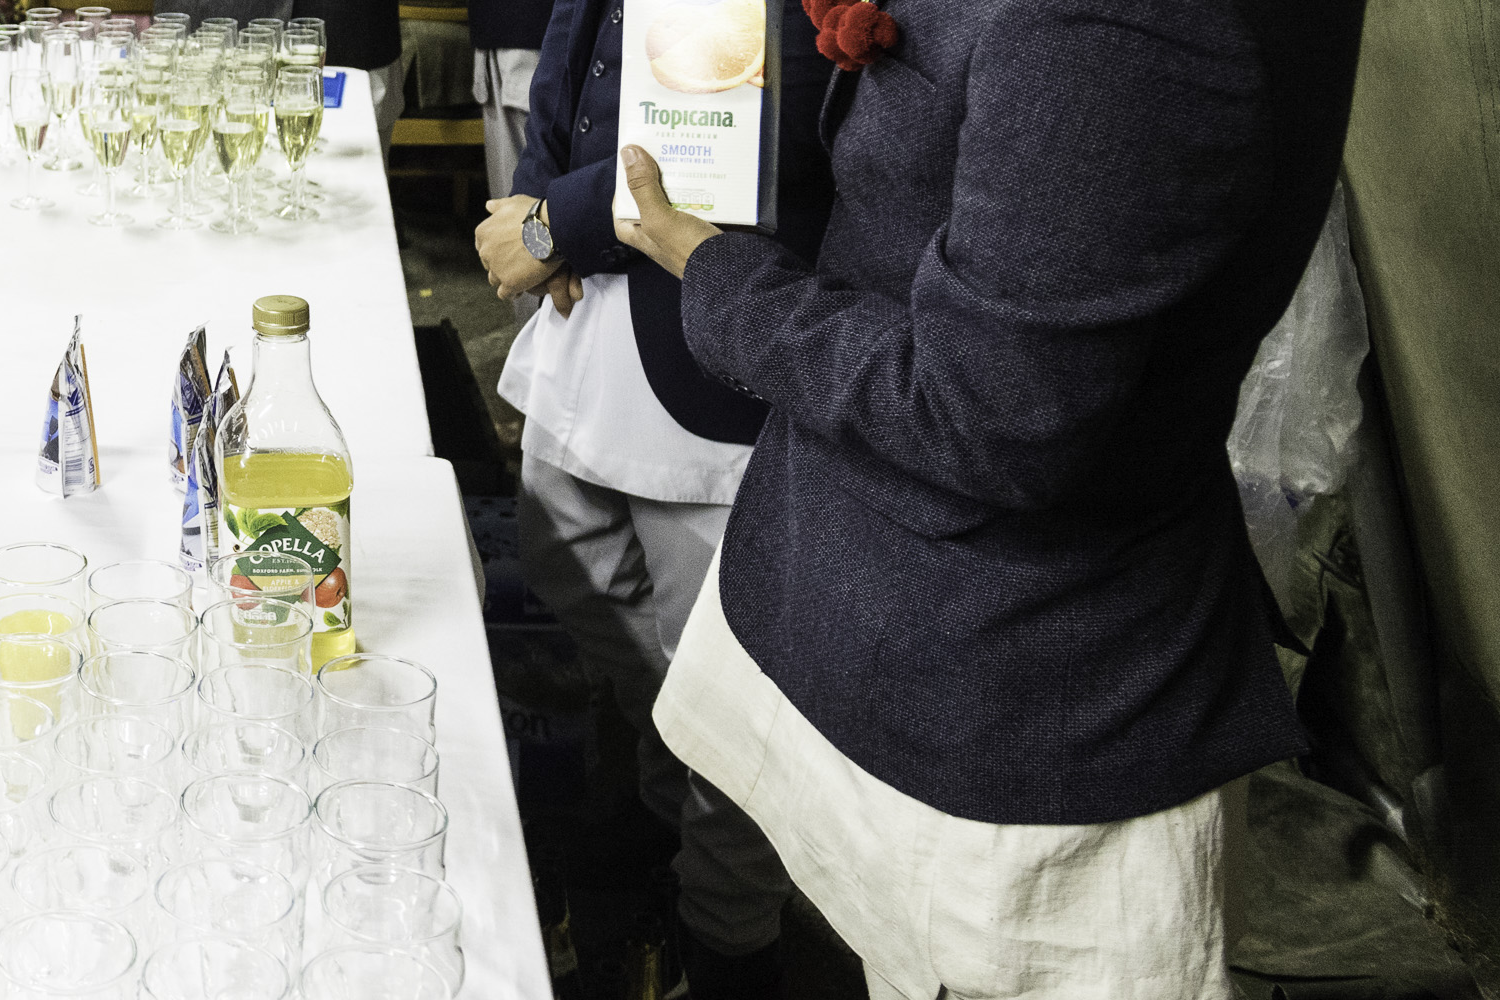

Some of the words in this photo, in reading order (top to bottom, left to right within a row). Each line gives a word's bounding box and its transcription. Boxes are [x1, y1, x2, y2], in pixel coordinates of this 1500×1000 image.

[639, 101, 734, 129] Tropicana
[661, 144, 712, 157] SMOOTH
[249, 537, 325, 564] COPELLA
